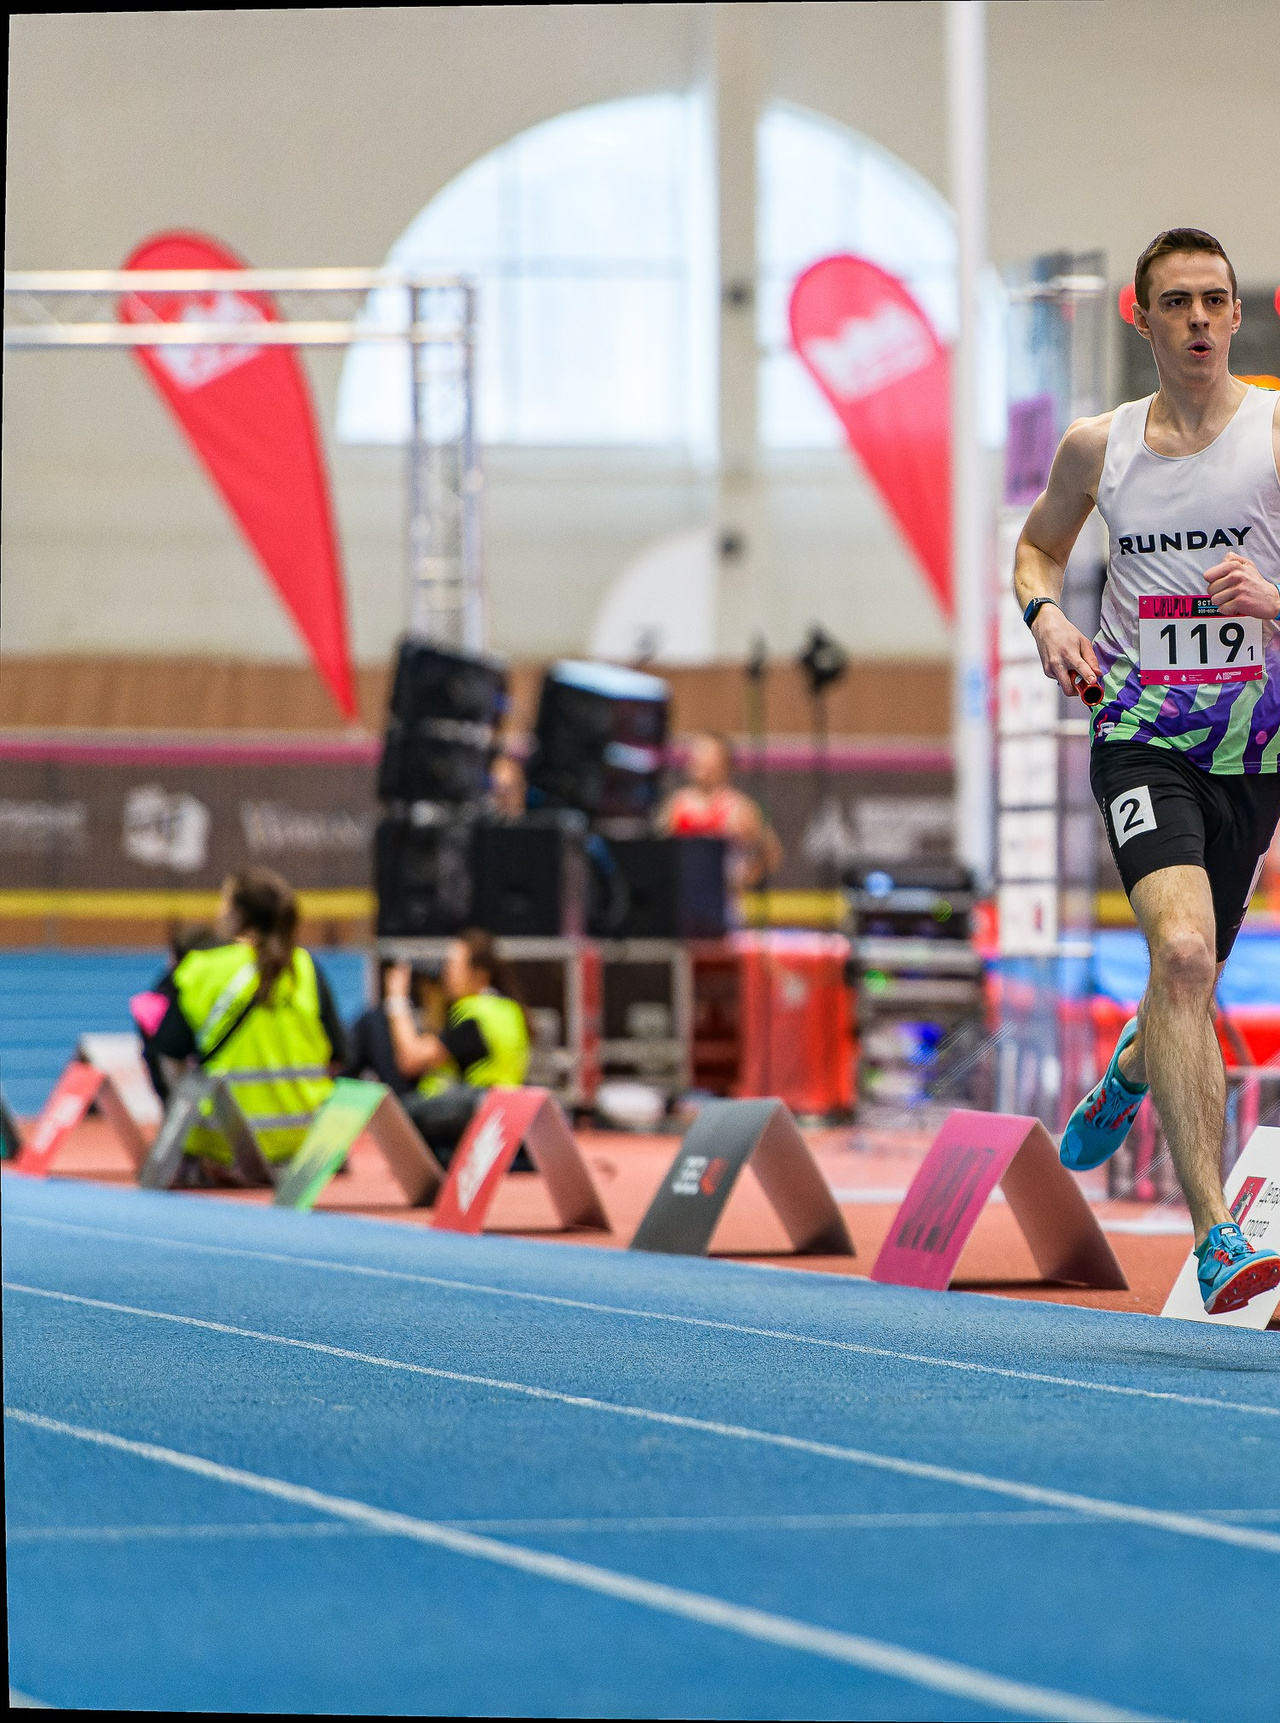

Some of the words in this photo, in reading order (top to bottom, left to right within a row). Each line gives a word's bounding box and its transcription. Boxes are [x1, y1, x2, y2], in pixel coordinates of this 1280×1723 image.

[1118, 526, 1252, 555] RUNDAY
[1160, 622, 1245, 665] 119
[1247, 645, 1254, 661] 1
[1119, 798, 1144, 834] 2
